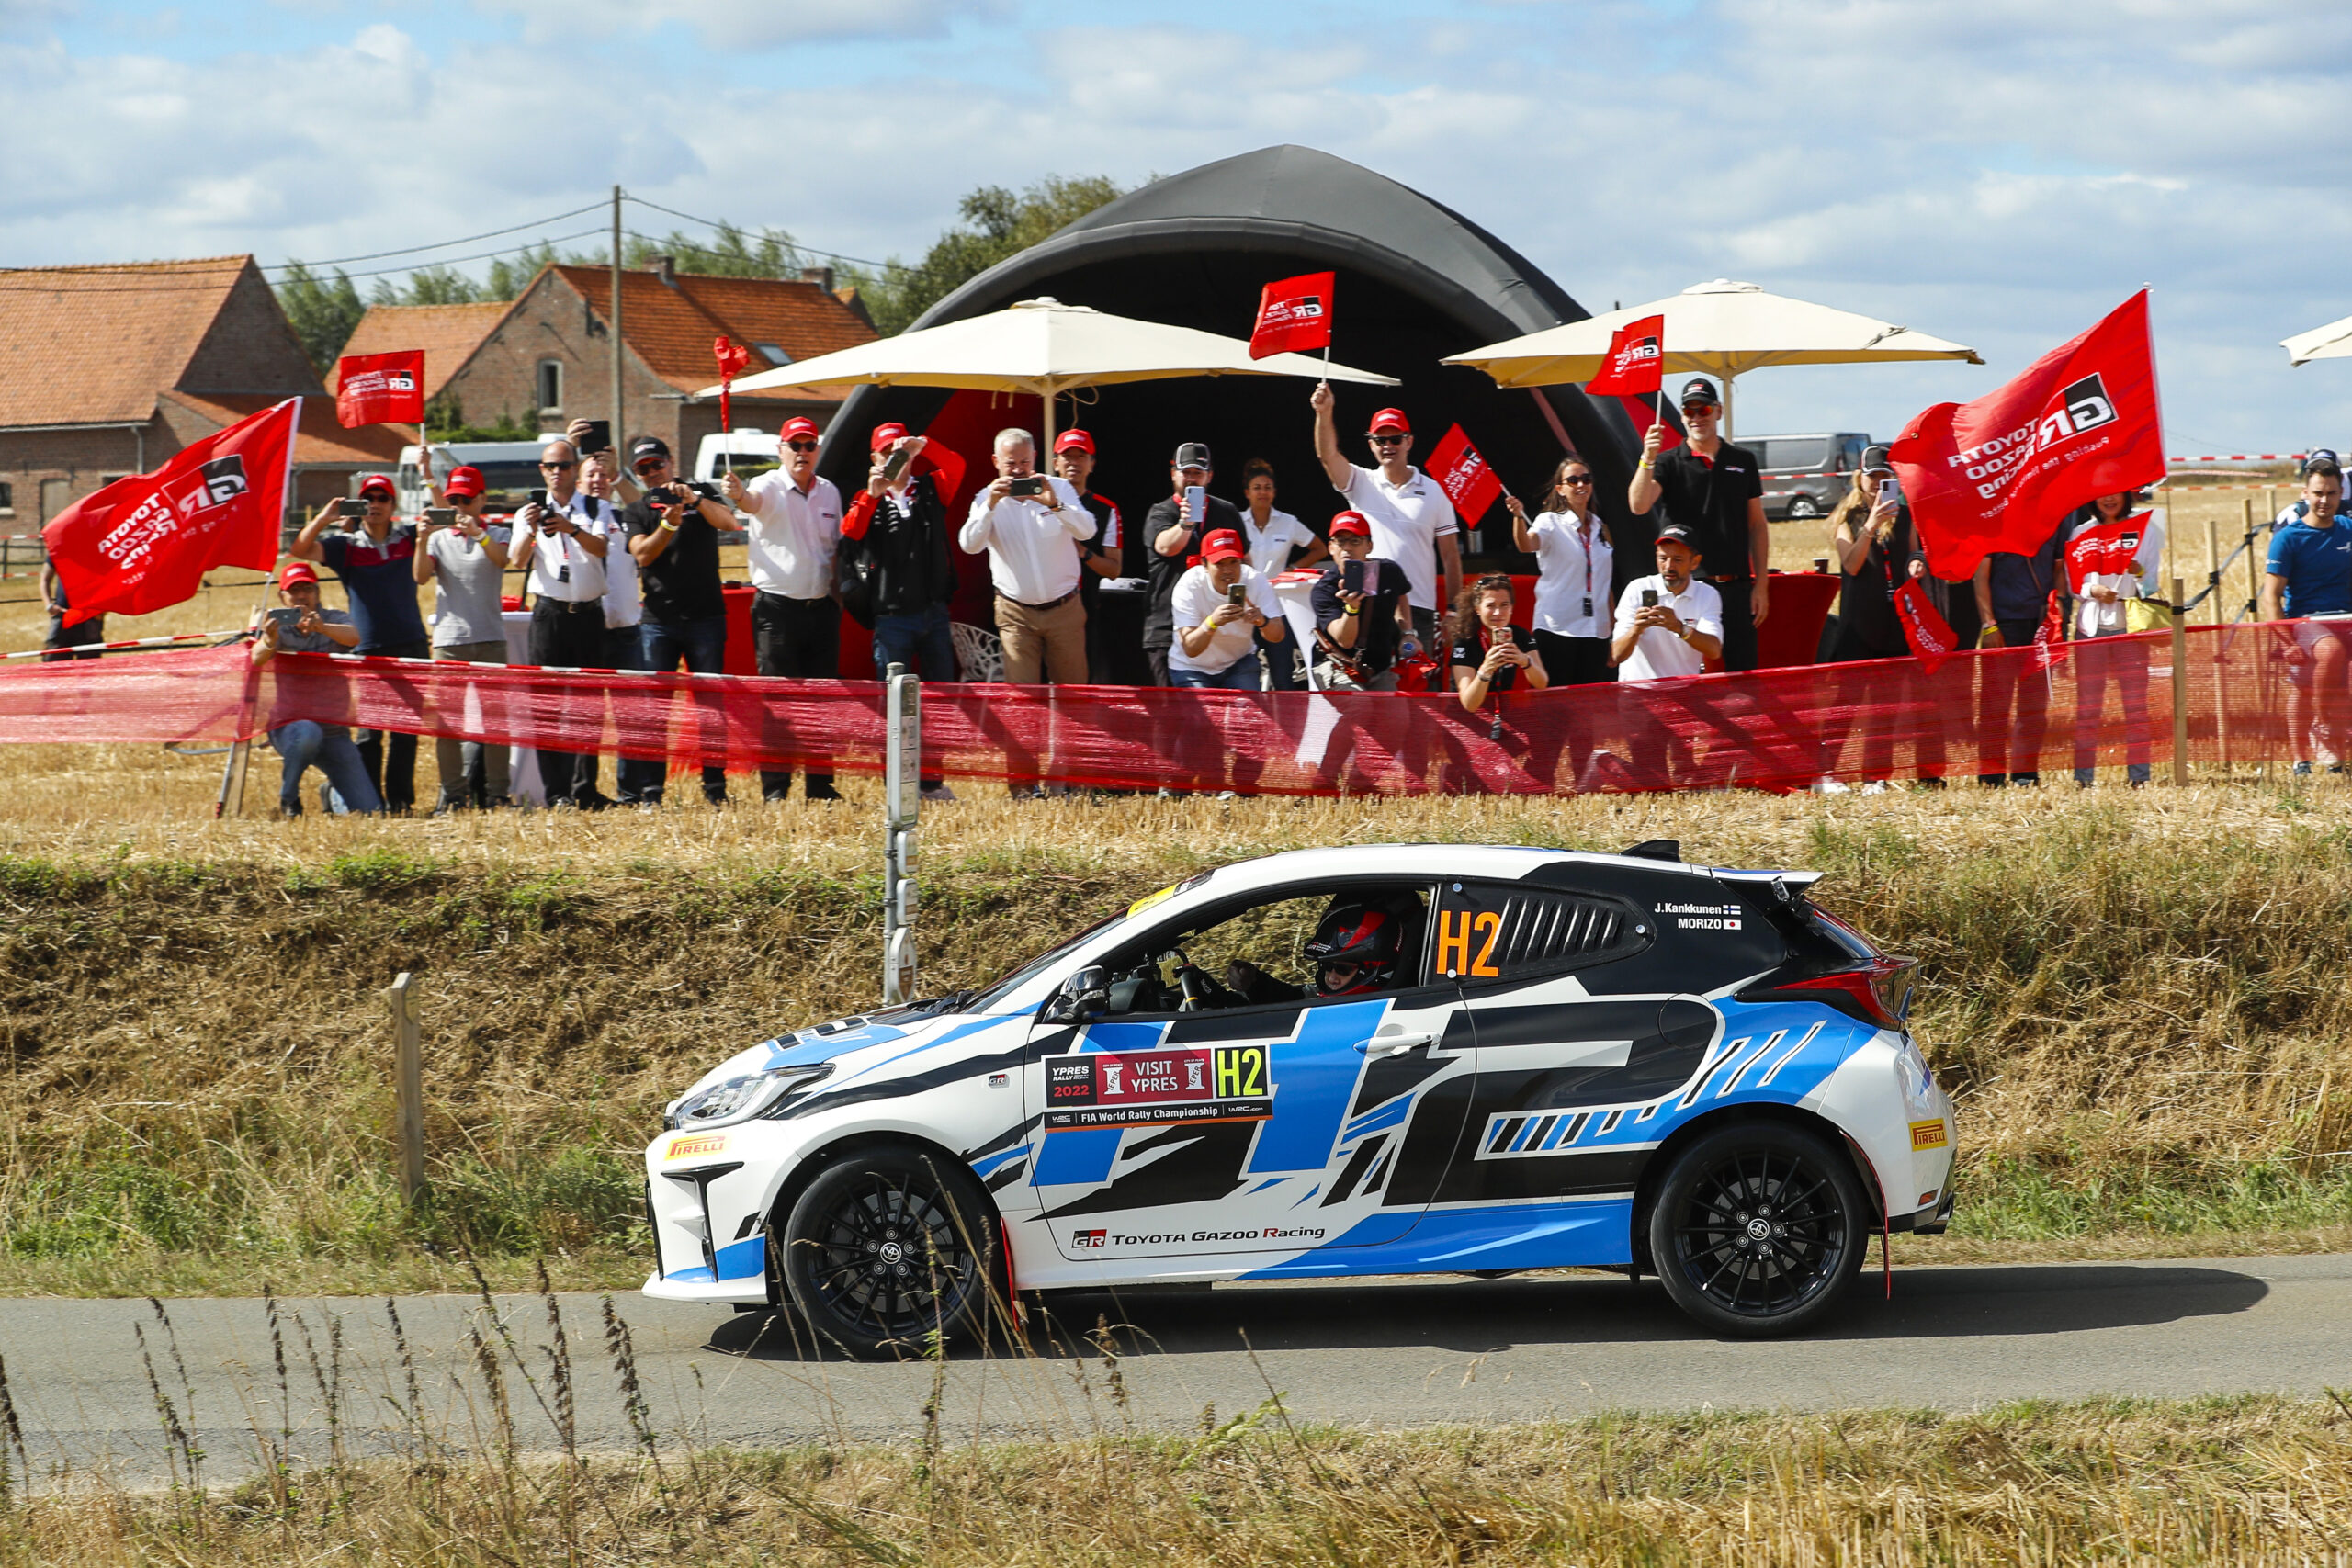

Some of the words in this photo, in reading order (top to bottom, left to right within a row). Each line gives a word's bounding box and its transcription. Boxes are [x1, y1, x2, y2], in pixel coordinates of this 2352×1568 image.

[1655, 902, 1722, 914] J.Kankkunen
[1678, 918, 1722, 929] MORIZO
[1436, 910, 1501, 977] H2
[1052, 1066, 1089, 1076] YPRES
[1135, 1060, 1173, 1076] VISIT
[1217, 1048, 1264, 1097] H2
[1054, 1084, 1090, 1097] 2022
[1131, 1077, 1178, 1093] YPRES
[1081, 1113, 1097, 1122] FIA
[1099, 1111, 1125, 1121] World
[1129, 1110, 1151, 1120] Rally
[1154, 1106, 1218, 1119] Championship
[1912, 1124, 1945, 1146] PIRELLI
[669, 1136, 726, 1156] PIRELLI
[1073, 1234, 1106, 1248] GR
[1111, 1233, 1186, 1245] TOYOTA
[1191, 1230, 1258, 1242] GAZOO
[1263, 1227, 1325, 1239] Racing
